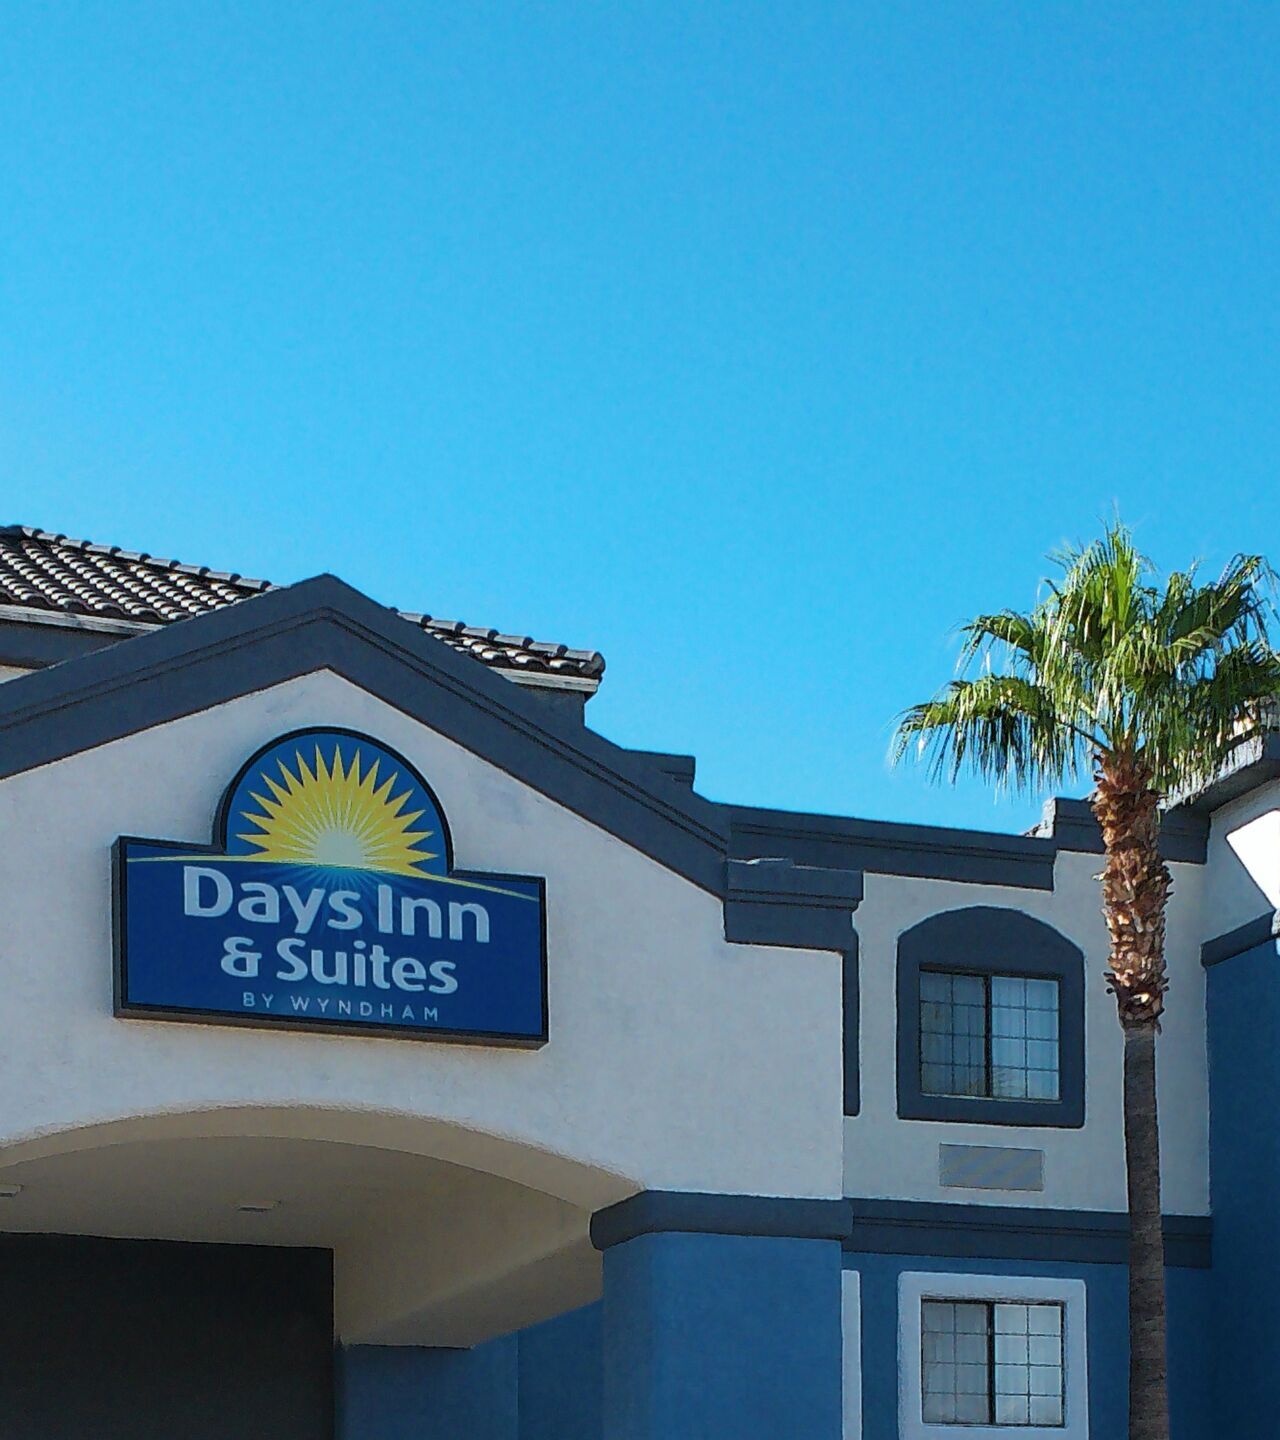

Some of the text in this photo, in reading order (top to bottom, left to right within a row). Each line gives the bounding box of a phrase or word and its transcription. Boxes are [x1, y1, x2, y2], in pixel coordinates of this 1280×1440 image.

[183, 866, 490, 943] Days Inn
[220, 936, 458, 994] & Suites
[242, 992, 439, 1022] BY WYNDHAM
